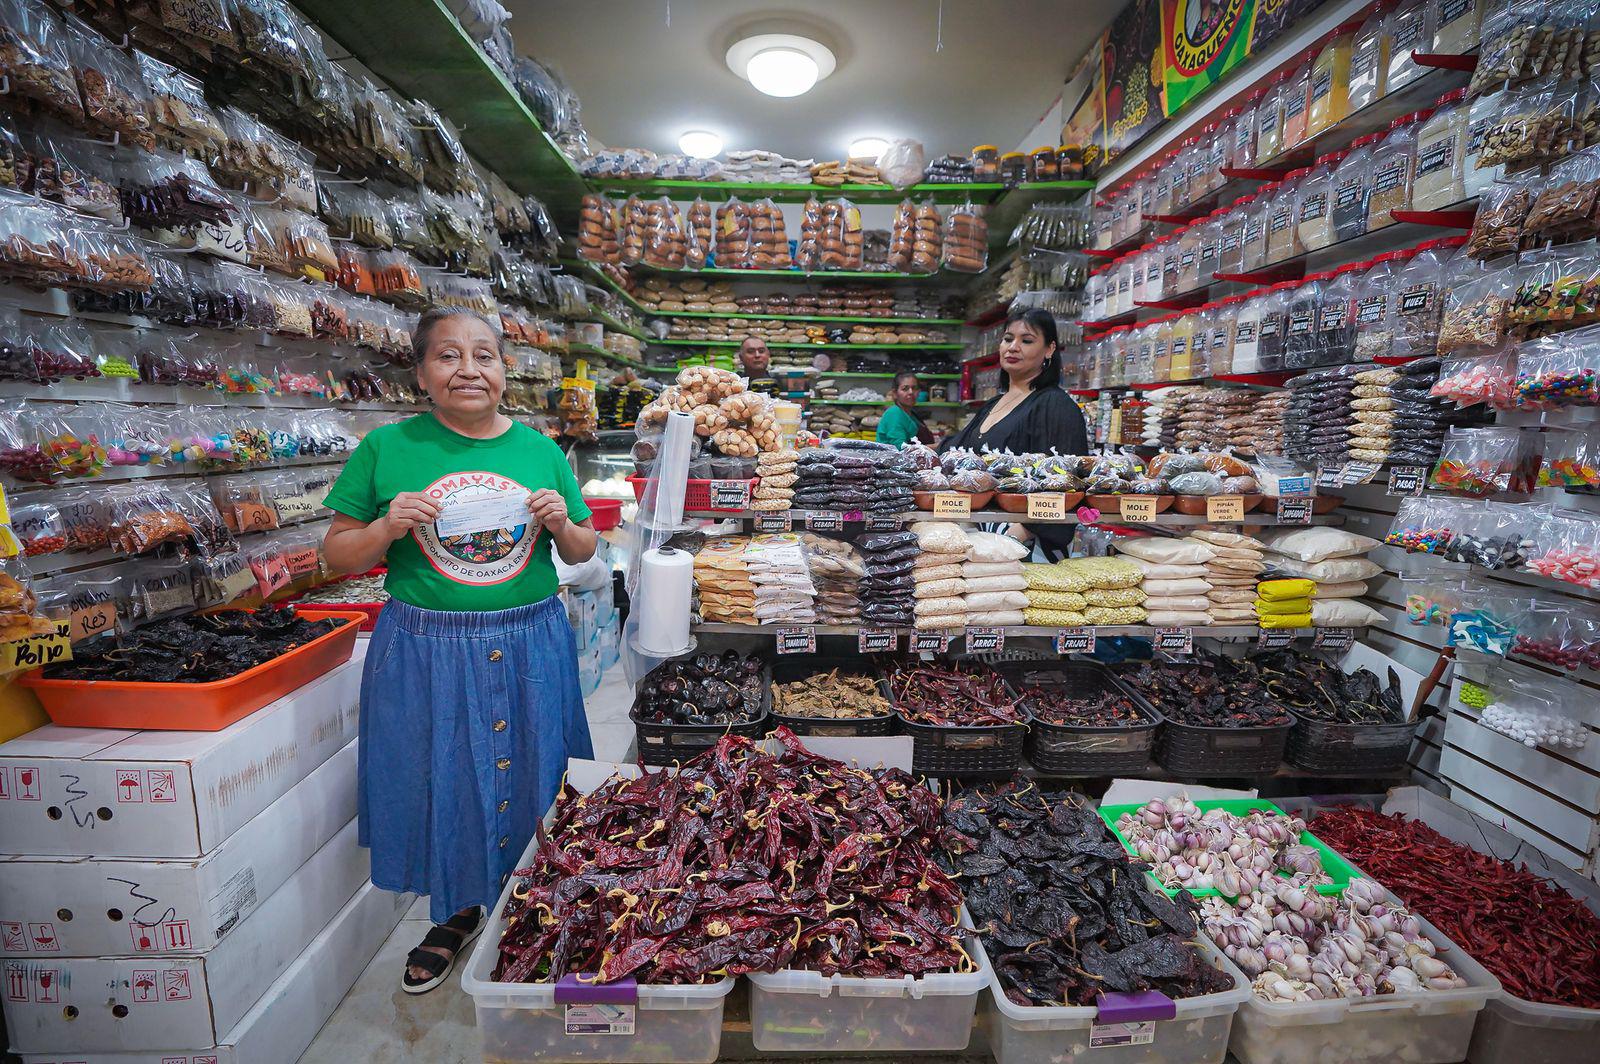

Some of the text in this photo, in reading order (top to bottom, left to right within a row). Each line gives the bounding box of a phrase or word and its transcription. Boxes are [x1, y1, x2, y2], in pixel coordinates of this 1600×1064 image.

[1404, 296, 1426, 309] NUEZ
[1395, 479, 1416, 490] PASAS
[1035, 501, 1058, 509] MOLE
[1032, 511, 1061, 519] NEGRO
[1125, 514, 1149, 522] ROJO
[419, 525, 460, 572] RINCONCITO
[460, 568, 474, 577] DE
[476, 563, 515, 578] OAXACA
[513, 553, 525, 565] EN
[81, 611, 107, 634] Res
[867, 639, 890, 647] JAMAICA
[917, 640, 939, 648] AVENA
[973, 639, 997, 647] ARROZ
[1064, 639, 1087, 648] FRIJOL
